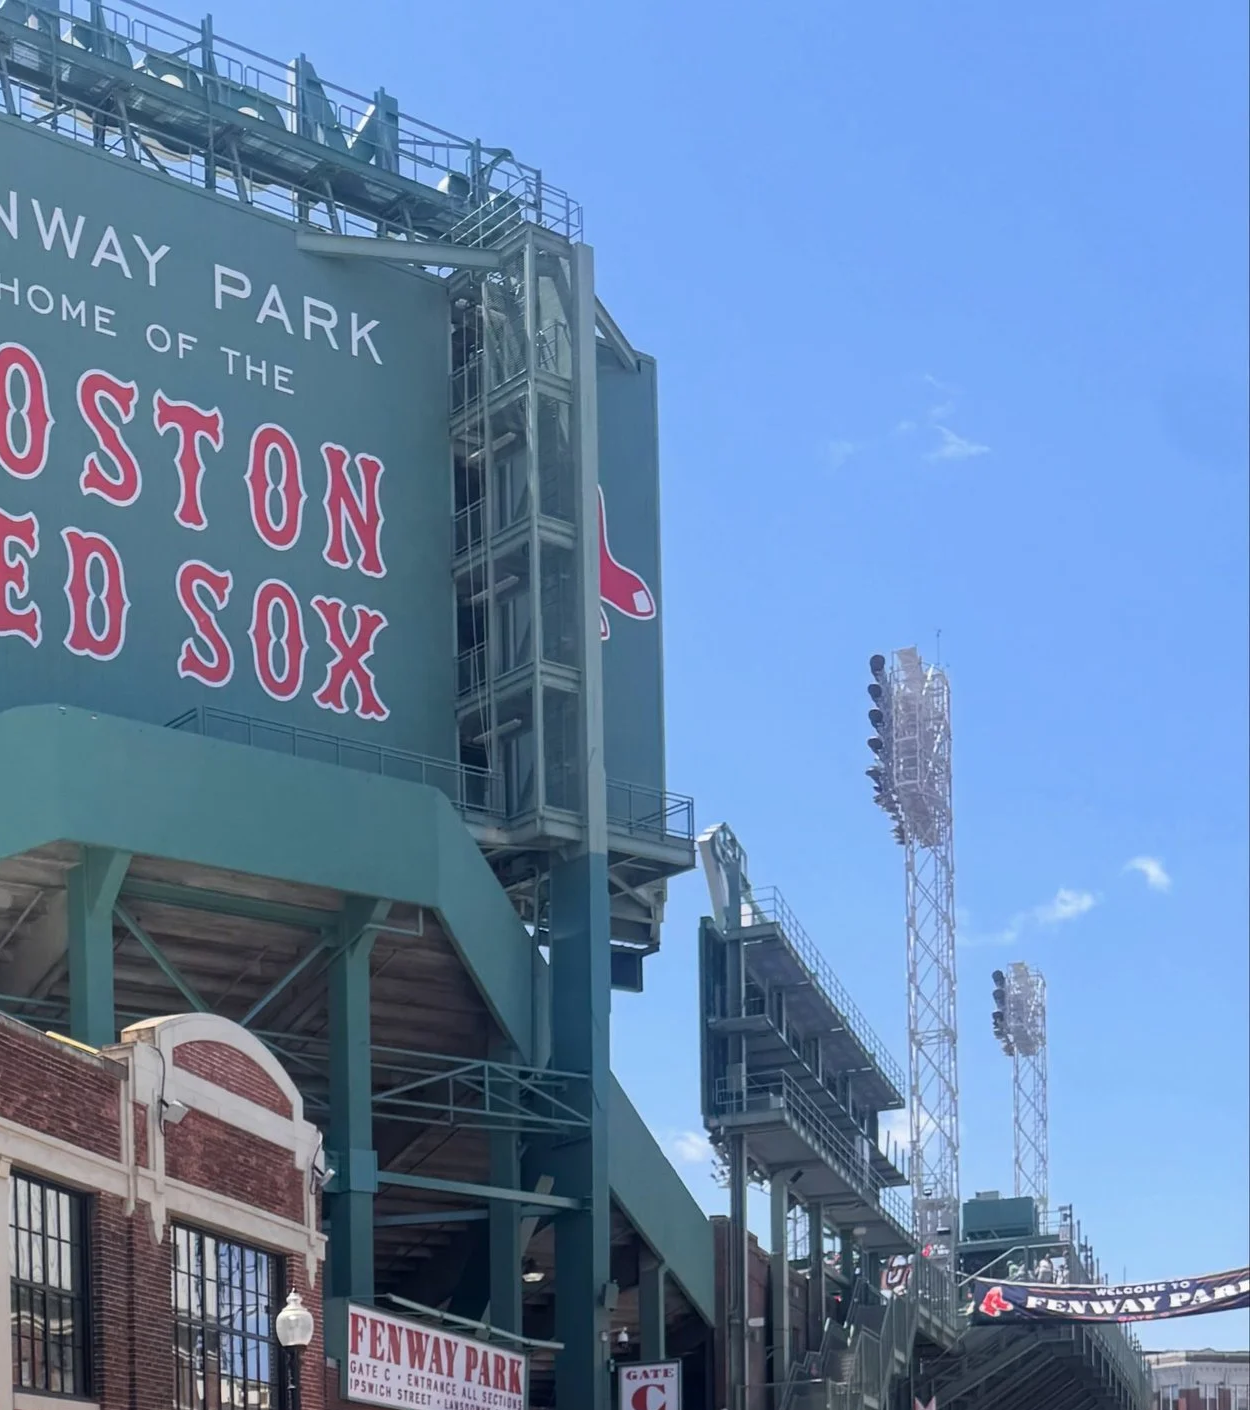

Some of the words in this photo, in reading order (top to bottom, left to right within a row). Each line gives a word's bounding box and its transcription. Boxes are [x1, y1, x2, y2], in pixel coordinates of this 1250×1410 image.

[214, 263, 383, 365] PARK
[145, 325, 198, 360] OF
[220, 346, 295, 395] THE
[175, 559, 390, 722] SOX
[1025, 1295, 1162, 1315] FENWAY
[1095, 1283, 1166, 1296] WELCOME
[1171, 1280, 1191, 1290] TO
[350, 1312, 459, 1378] FENWAY
[465, 1345, 522, 1396] PARK
[626, 1367, 675, 1381] GATE
[350, 1360, 378, 1379] GATE
[384, 1367, 391, 1382] C
[407, 1373, 456, 1396] ENTRANCE
[461, 1386, 478, 1401] ALL
[350, 1378, 392, 1398] IPSWICH
[397, 1388, 432, 1406] STREET
